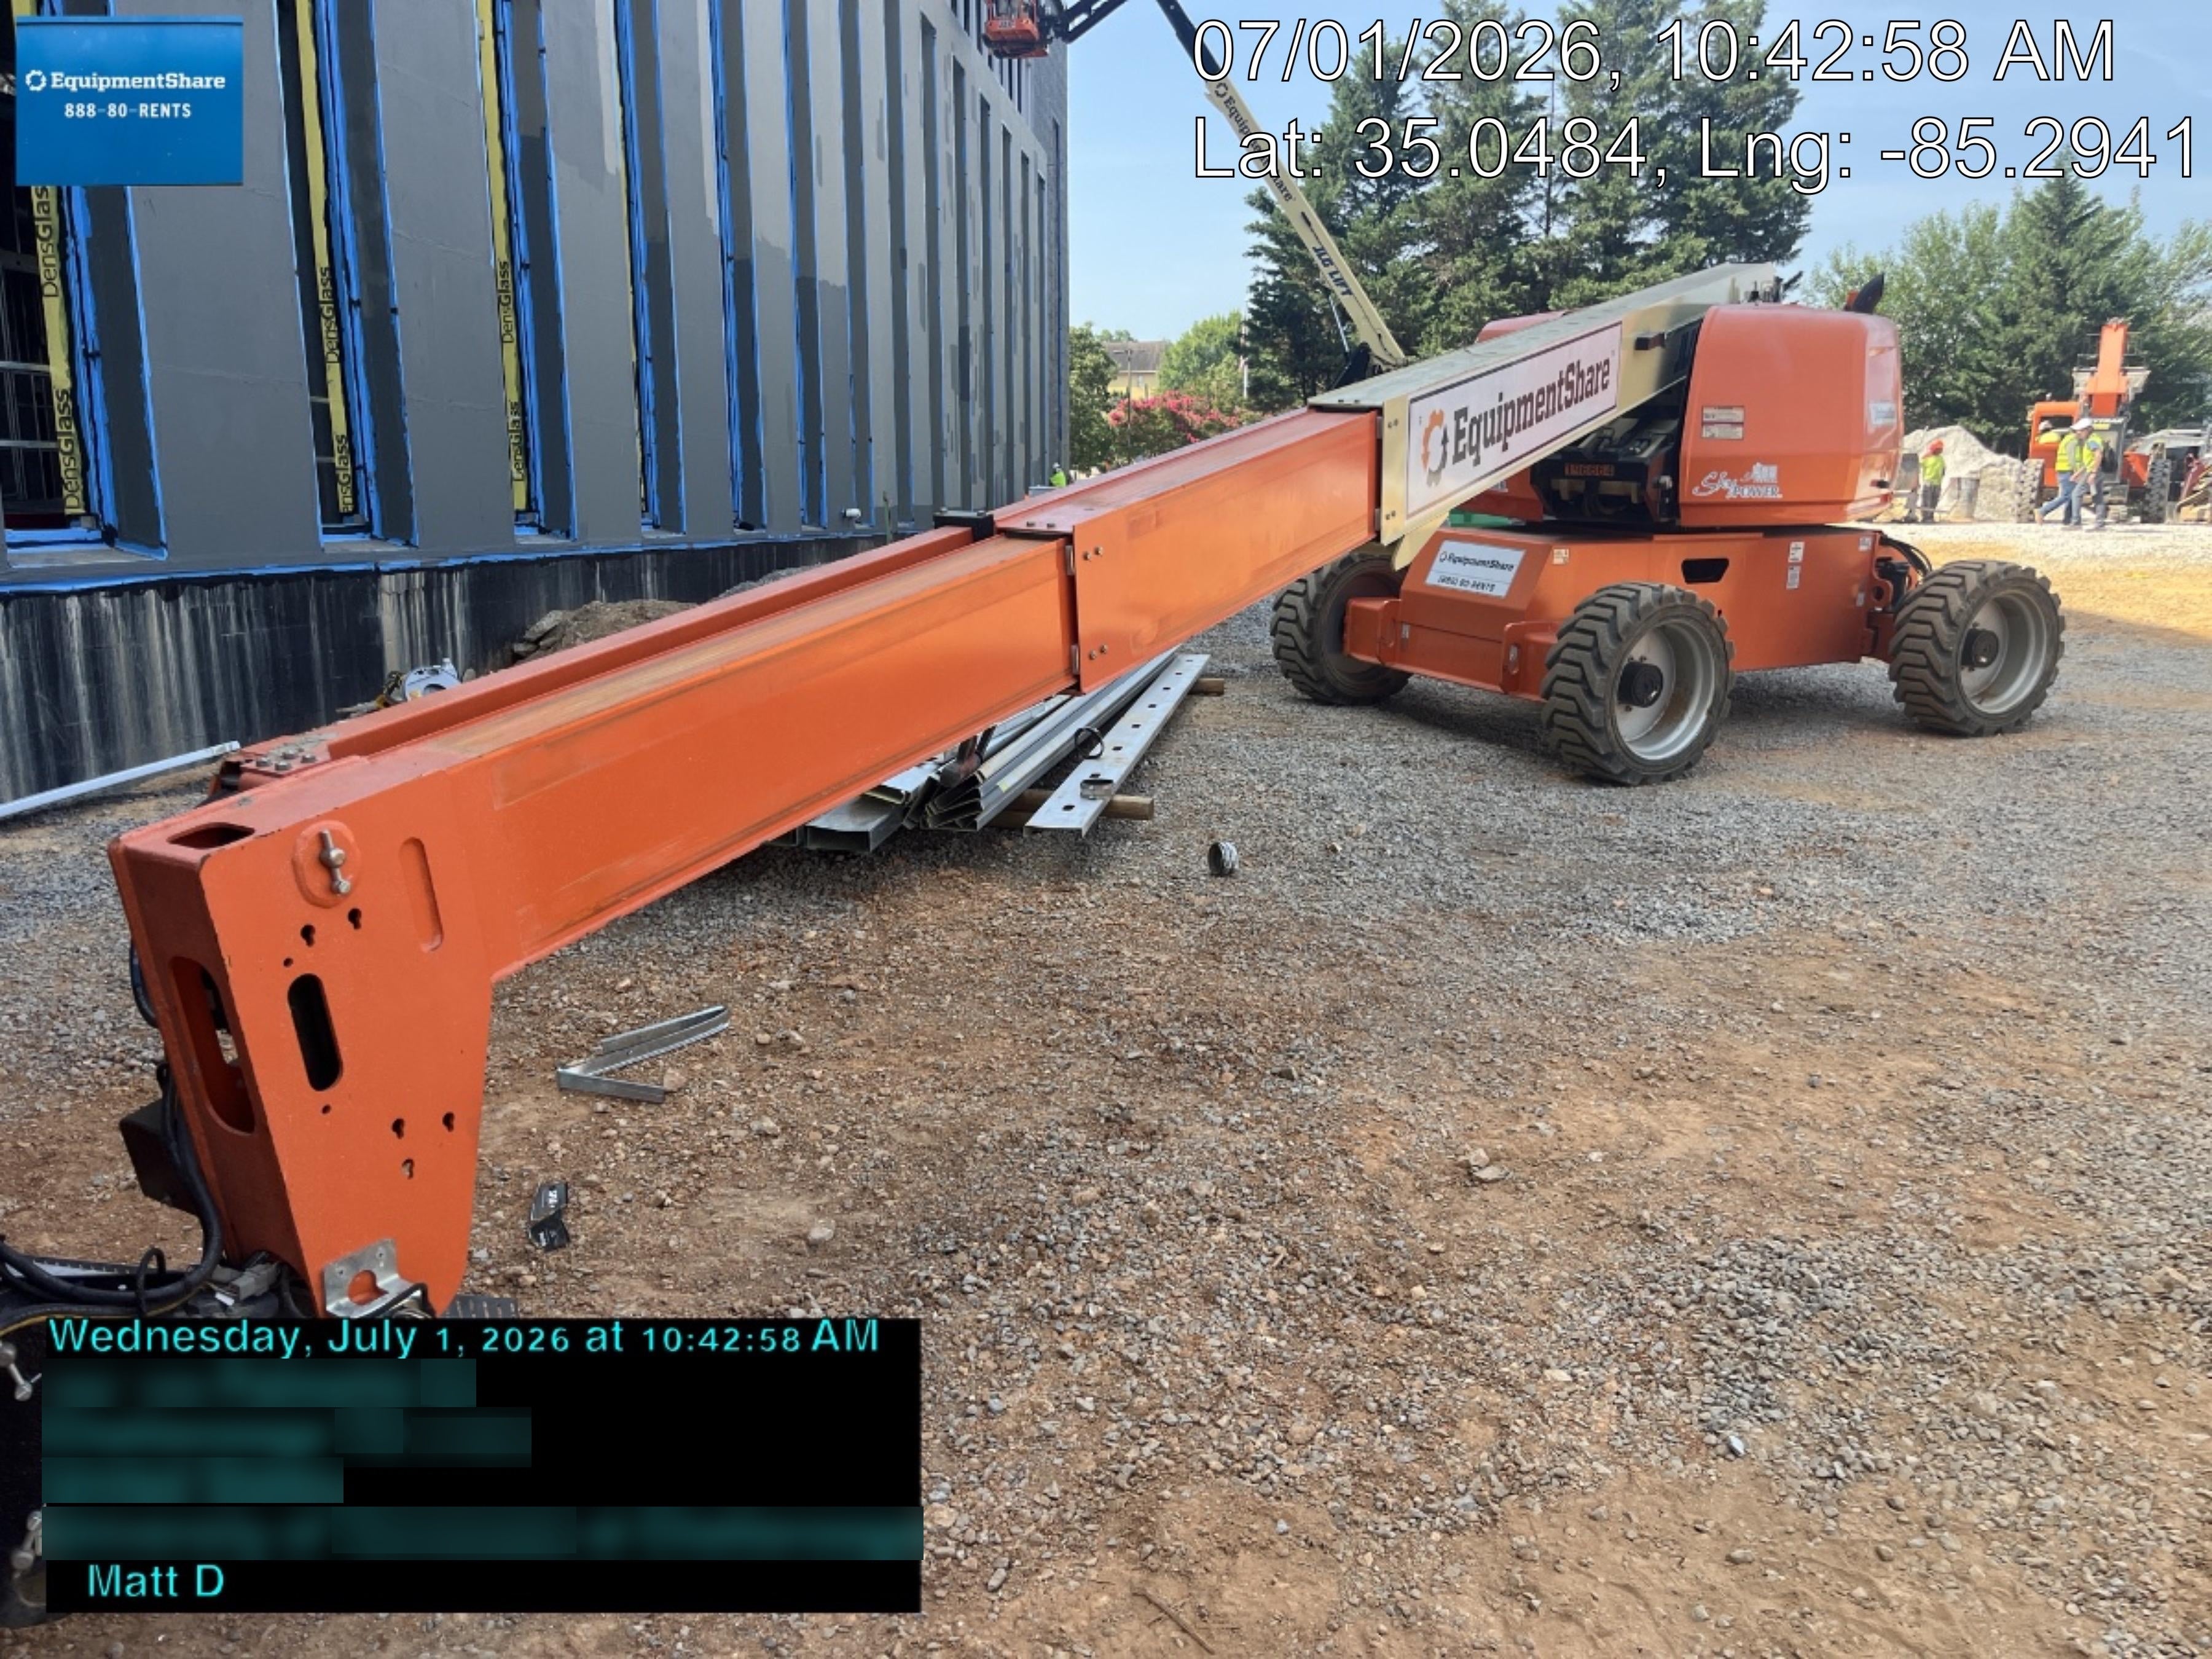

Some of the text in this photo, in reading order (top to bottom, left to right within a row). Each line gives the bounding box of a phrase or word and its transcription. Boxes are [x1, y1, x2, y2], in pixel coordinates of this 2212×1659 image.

[34, 186, 60, 297] DensGlas
[320, 267, 340, 361] DensGlass
[56, 388, 81, 509] DensGlass
[1452, 357, 1610, 467] EquipmentShare
[335, 434, 355, 512] ensGlass
